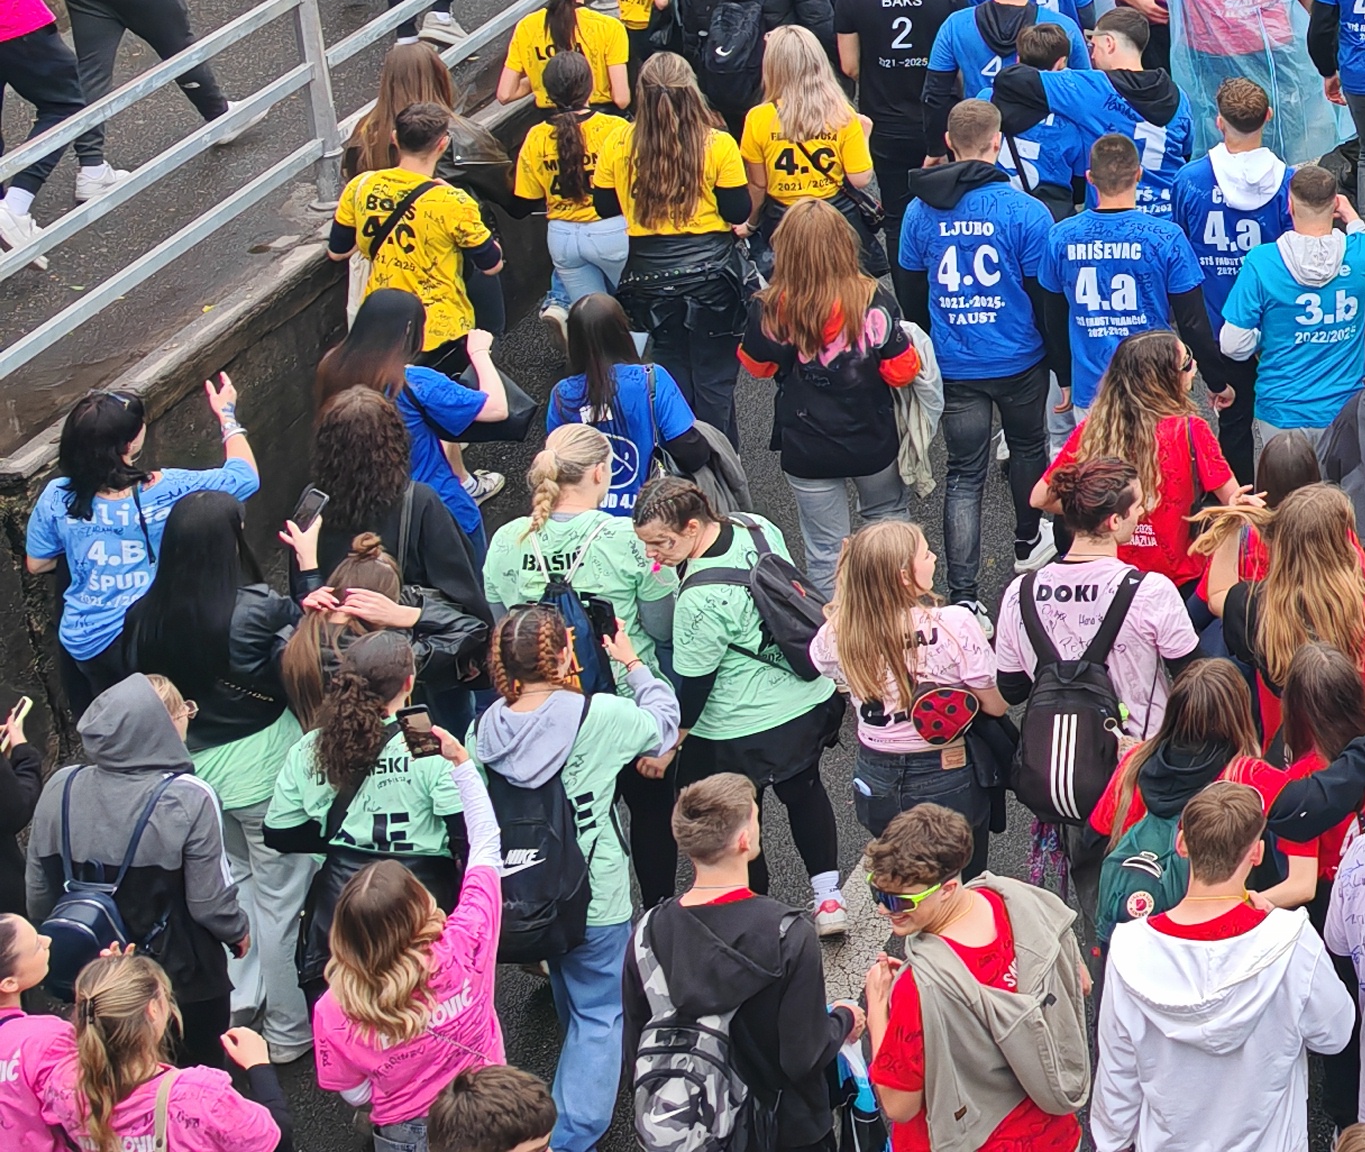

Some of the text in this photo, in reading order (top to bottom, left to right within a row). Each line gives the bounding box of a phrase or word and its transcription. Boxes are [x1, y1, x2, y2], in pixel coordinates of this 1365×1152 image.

[891, 17, 913, 49] 2
[774, 148, 836, 176] 4.C
[1204, 210, 1260, 253] 4.a
[1068, 241, 1142, 261] BRIŠEVAC
[937, 246, 1001, 291] 4.C
[1076, 268, 1138, 311] 4.a
[949, 312, 997, 325] FAUST
[1295, 290, 1358, 324] 3.b
[87, 539, 146, 567] 4.B
[89, 566, 150, 592] ŠPUD
[1036, 583, 1100, 603] DOKI
[506, 849, 539, 864] NIKE
